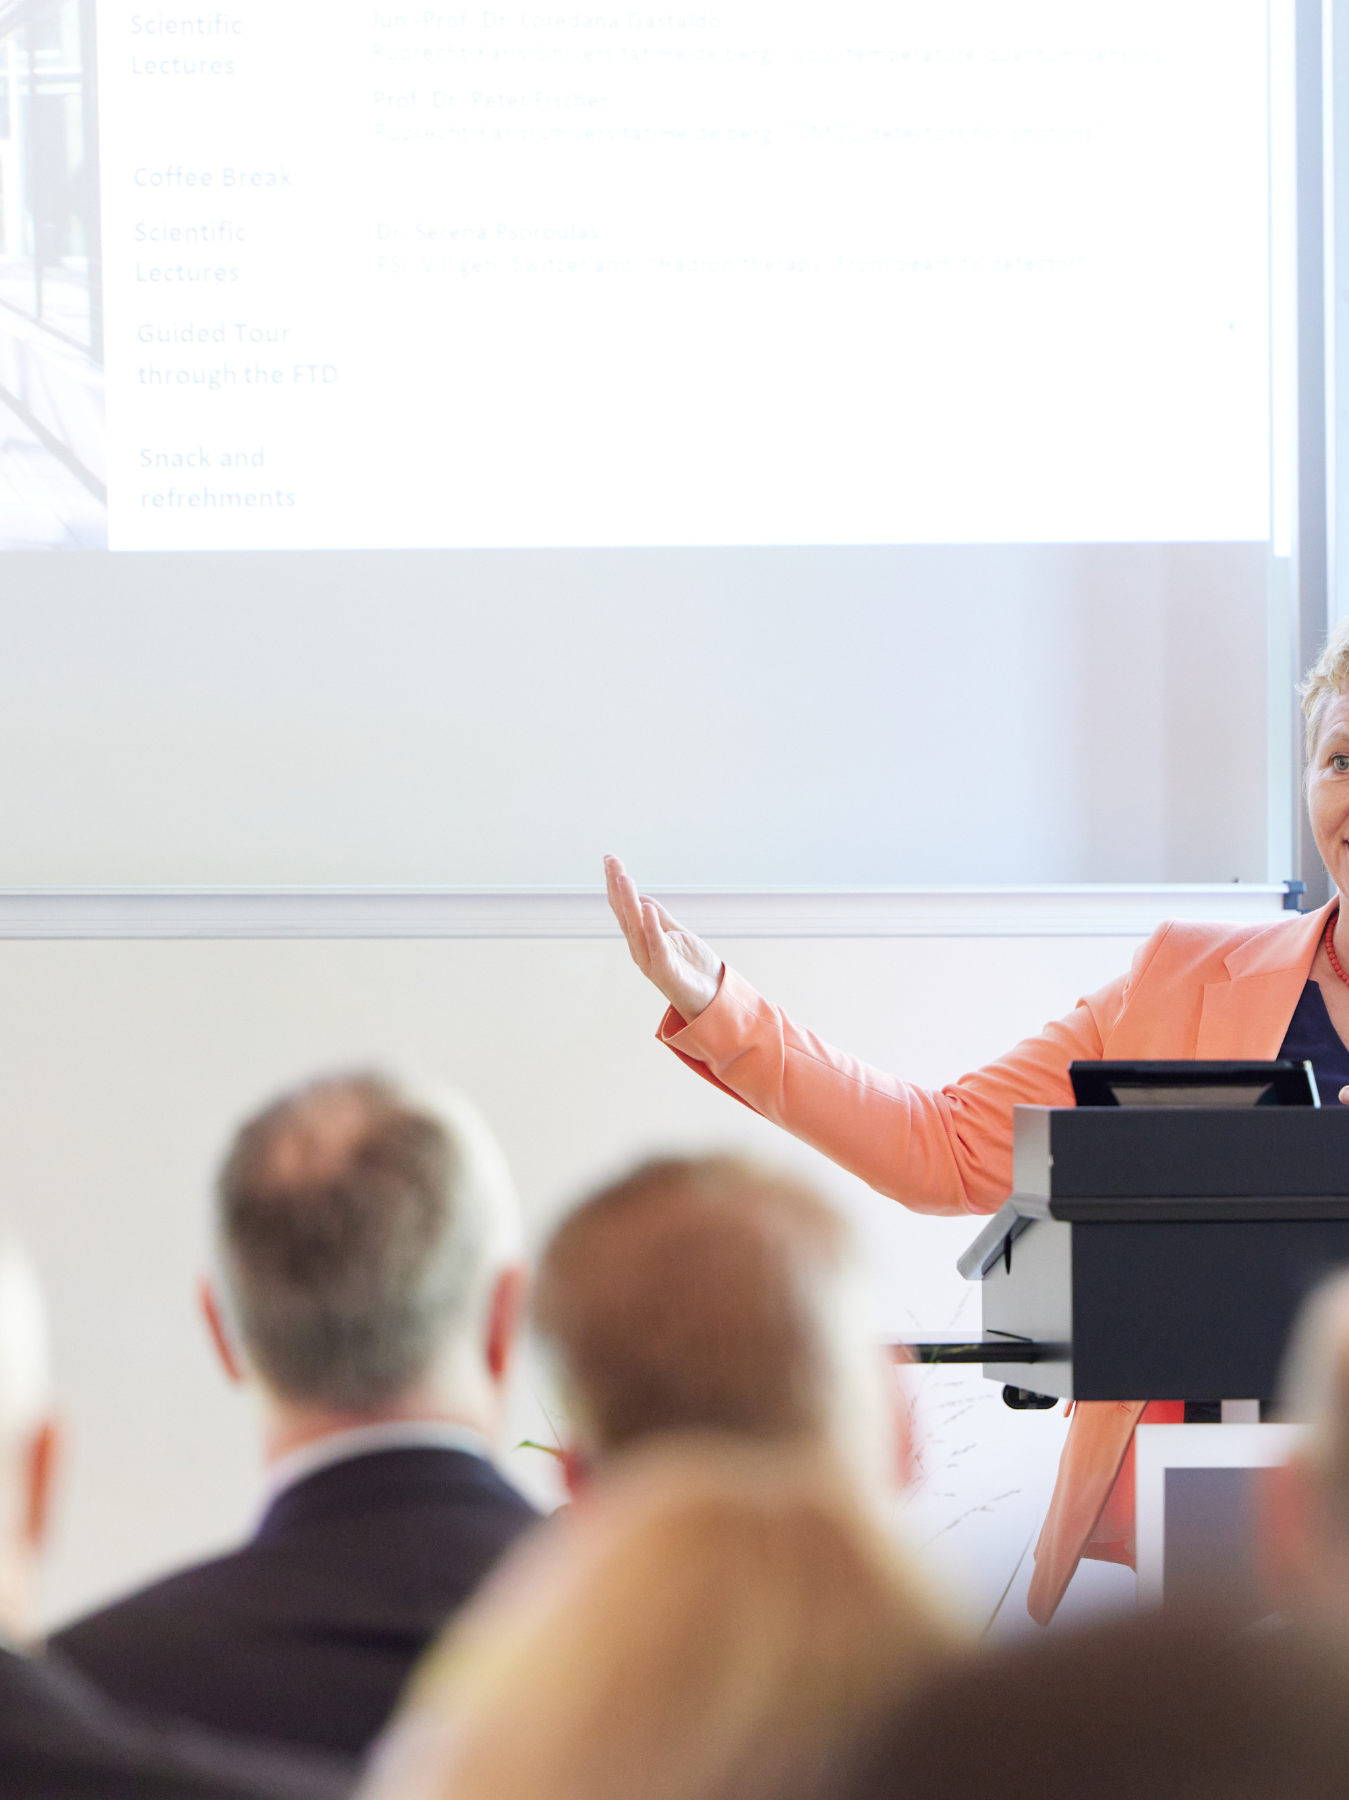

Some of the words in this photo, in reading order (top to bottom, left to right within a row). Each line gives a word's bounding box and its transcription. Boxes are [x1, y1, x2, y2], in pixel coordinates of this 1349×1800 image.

[130, 12, 243, 35] Scientific
[132, 55, 236, 75] Lectures
[470, 90, 528, 108] Peter
[133, 164, 214, 187] Coffee
[222, 164, 294, 187] Break
[134, 220, 247, 243] Scientific
[414, 223, 488, 241] Serena
[136, 262, 240, 283] Lectures
[137, 320, 227, 345] Guided
[233, 321, 290, 344] Tour
[138, 361, 239, 391] through
[243, 361, 285, 386] the
[293, 363, 339, 386] FTD
[140, 446, 213, 468] Snack
[220, 446, 266, 468] and
[141, 486, 297, 509] refrehments
